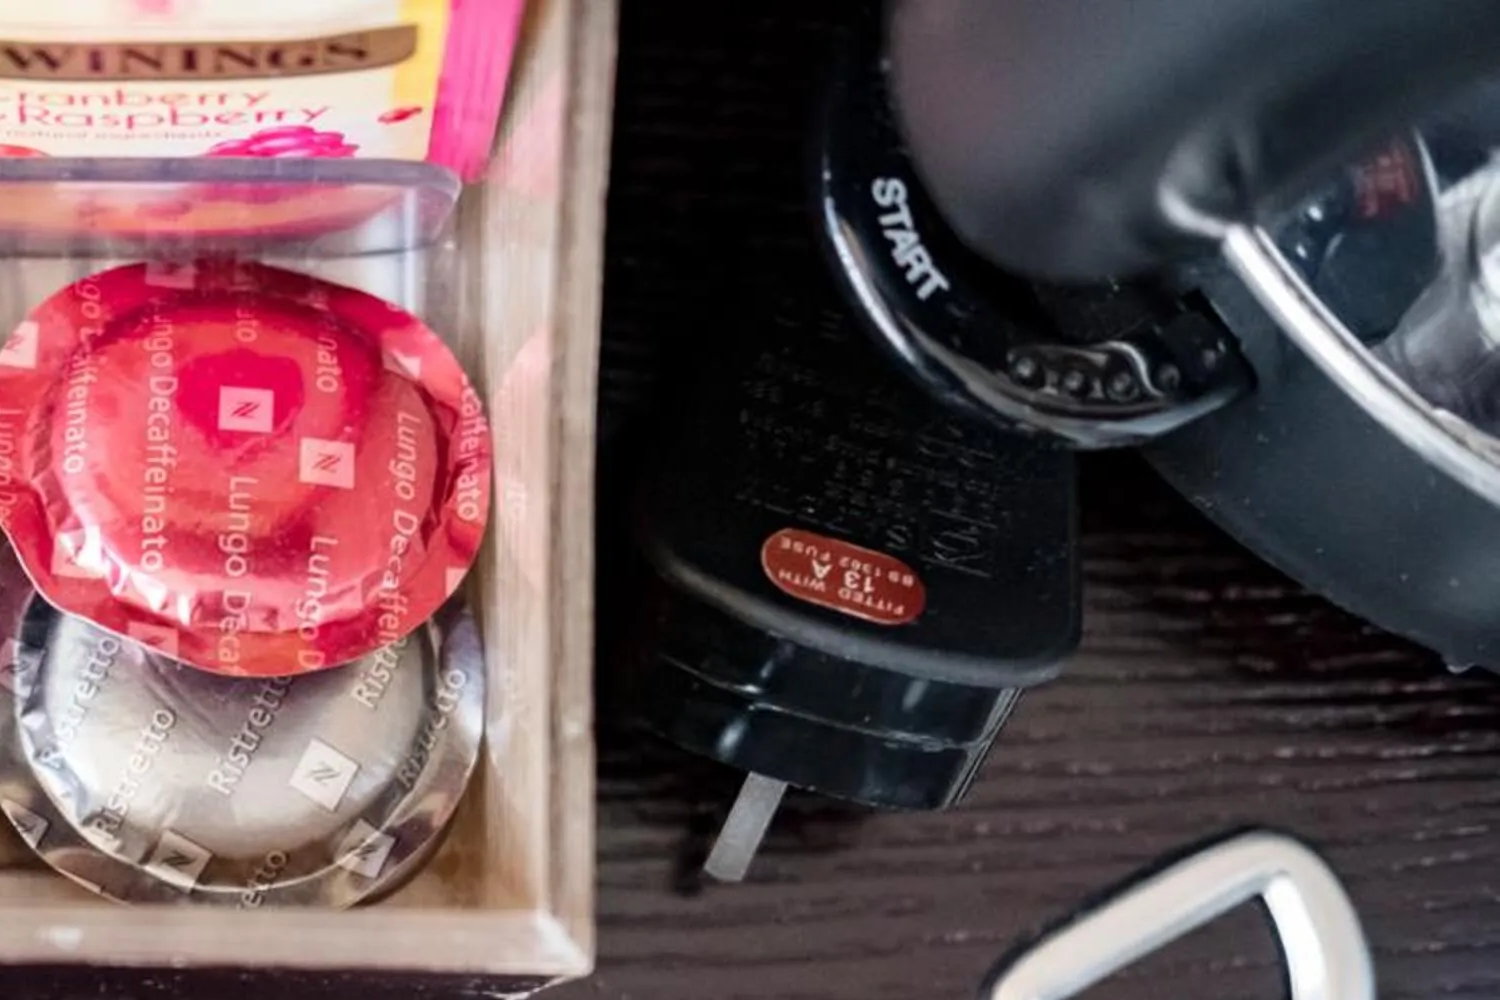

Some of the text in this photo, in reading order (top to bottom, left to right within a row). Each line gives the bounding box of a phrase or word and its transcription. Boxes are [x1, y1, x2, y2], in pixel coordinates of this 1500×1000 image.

[18, 103, 330, 130] Raspberry
[872, 176, 949, 300] START
[139, 374, 179, 576] Decaffeinato
[389, 411, 422, 503] Lungo
[220, 476, 259, 577] Lungo
[780, 535, 832, 562] FUSE
[296, 535, 339, 641] Lungo
[777, 569, 905, 616] FITTED WITH
[811, 559, 876, 594] 13 A
